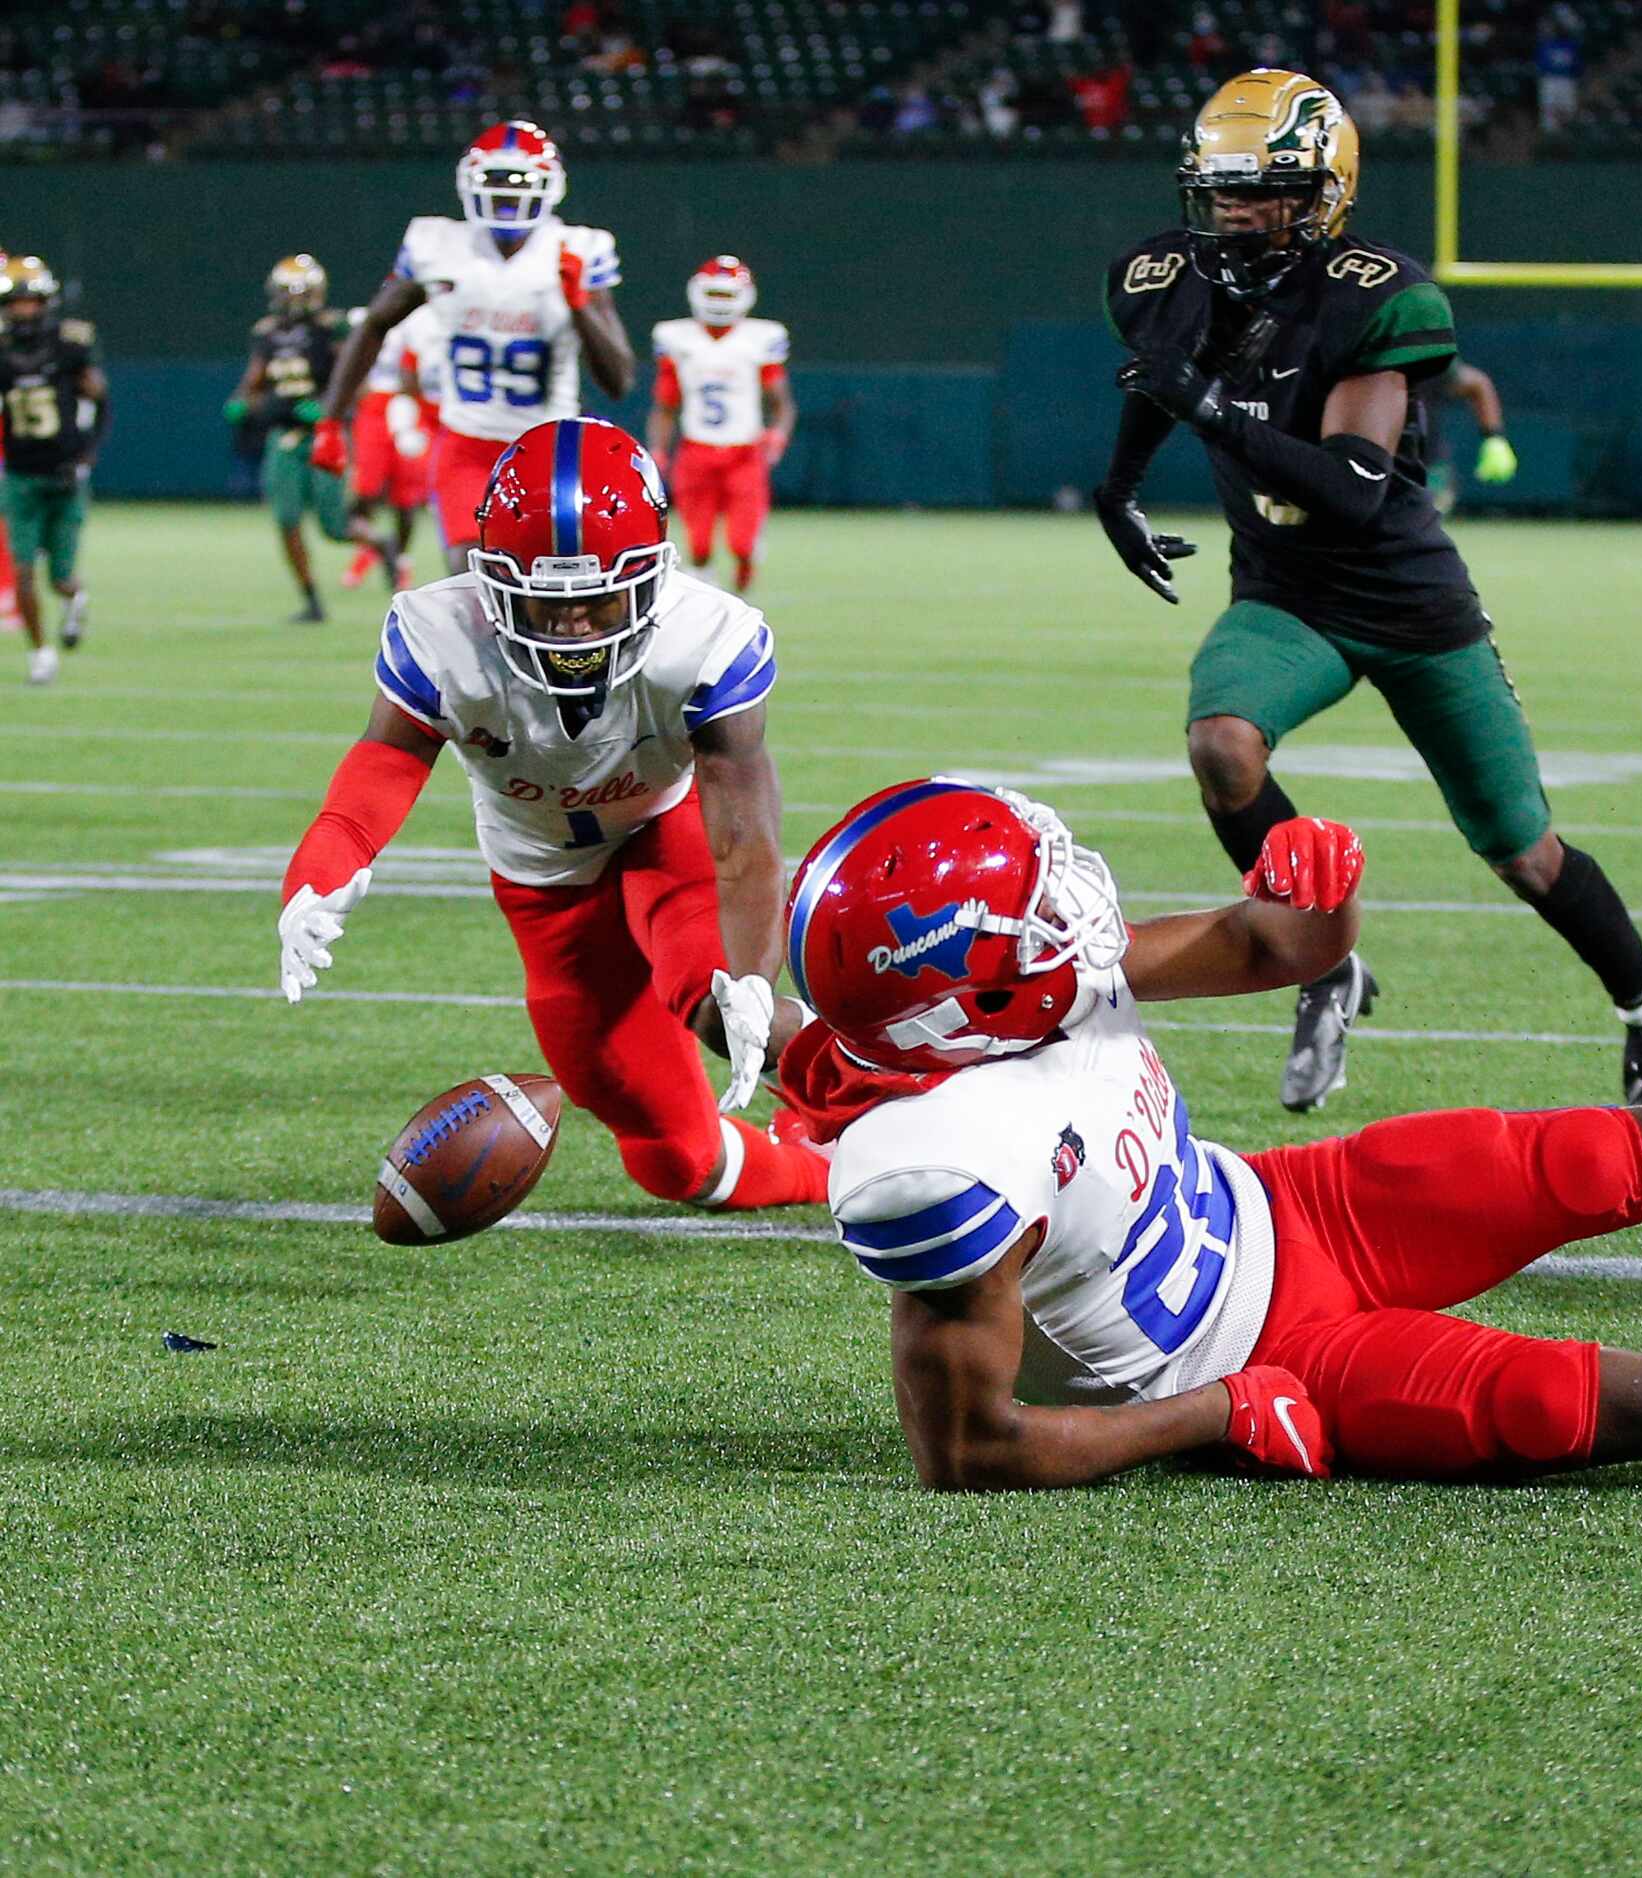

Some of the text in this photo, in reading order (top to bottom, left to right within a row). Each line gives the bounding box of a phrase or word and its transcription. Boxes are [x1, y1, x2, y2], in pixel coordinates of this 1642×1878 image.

[1123, 252, 1186, 294] 3
[1326, 249, 1400, 289] 3
[451, 333, 554, 407] 89
[698, 382, 728, 427] 5
[564, 811, 608, 848] 1
